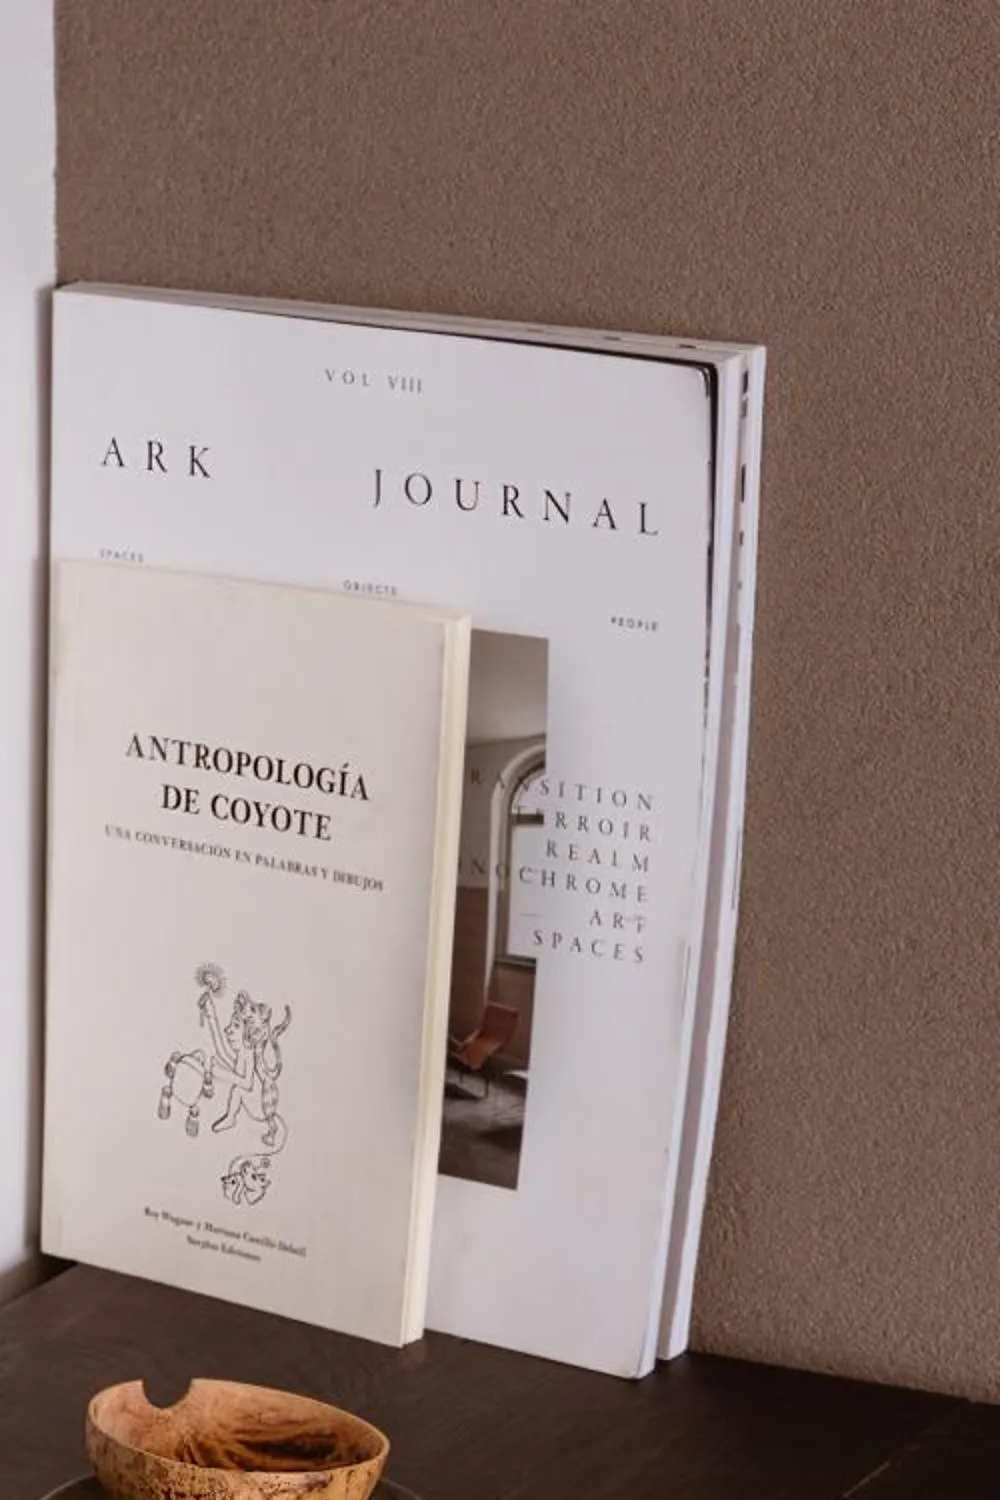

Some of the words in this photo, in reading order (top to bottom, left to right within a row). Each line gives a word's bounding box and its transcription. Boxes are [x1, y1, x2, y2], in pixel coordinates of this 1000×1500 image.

[325, 368, 370, 387] VOL
[388, 375, 423, 394] VIII
[101, 437, 212, 478] ARK
[373, 468, 659, 536] JOURNAL
[100, 548, 145, 563] SPACES
[343, 579, 398, 597] OBJECTS
[611, 615, 659, 632] PEOPLE
[126, 732, 370, 801] ANTROPOLOGÍA
[470, 767, 652, 811] RANSITION
[160, 783, 200, 815] DE
[210, 793, 332, 841] COYOTE
[545, 840, 651, 873] REALM
[589, 908, 648, 934] ART
[533, 929, 645, 964] SPACES
